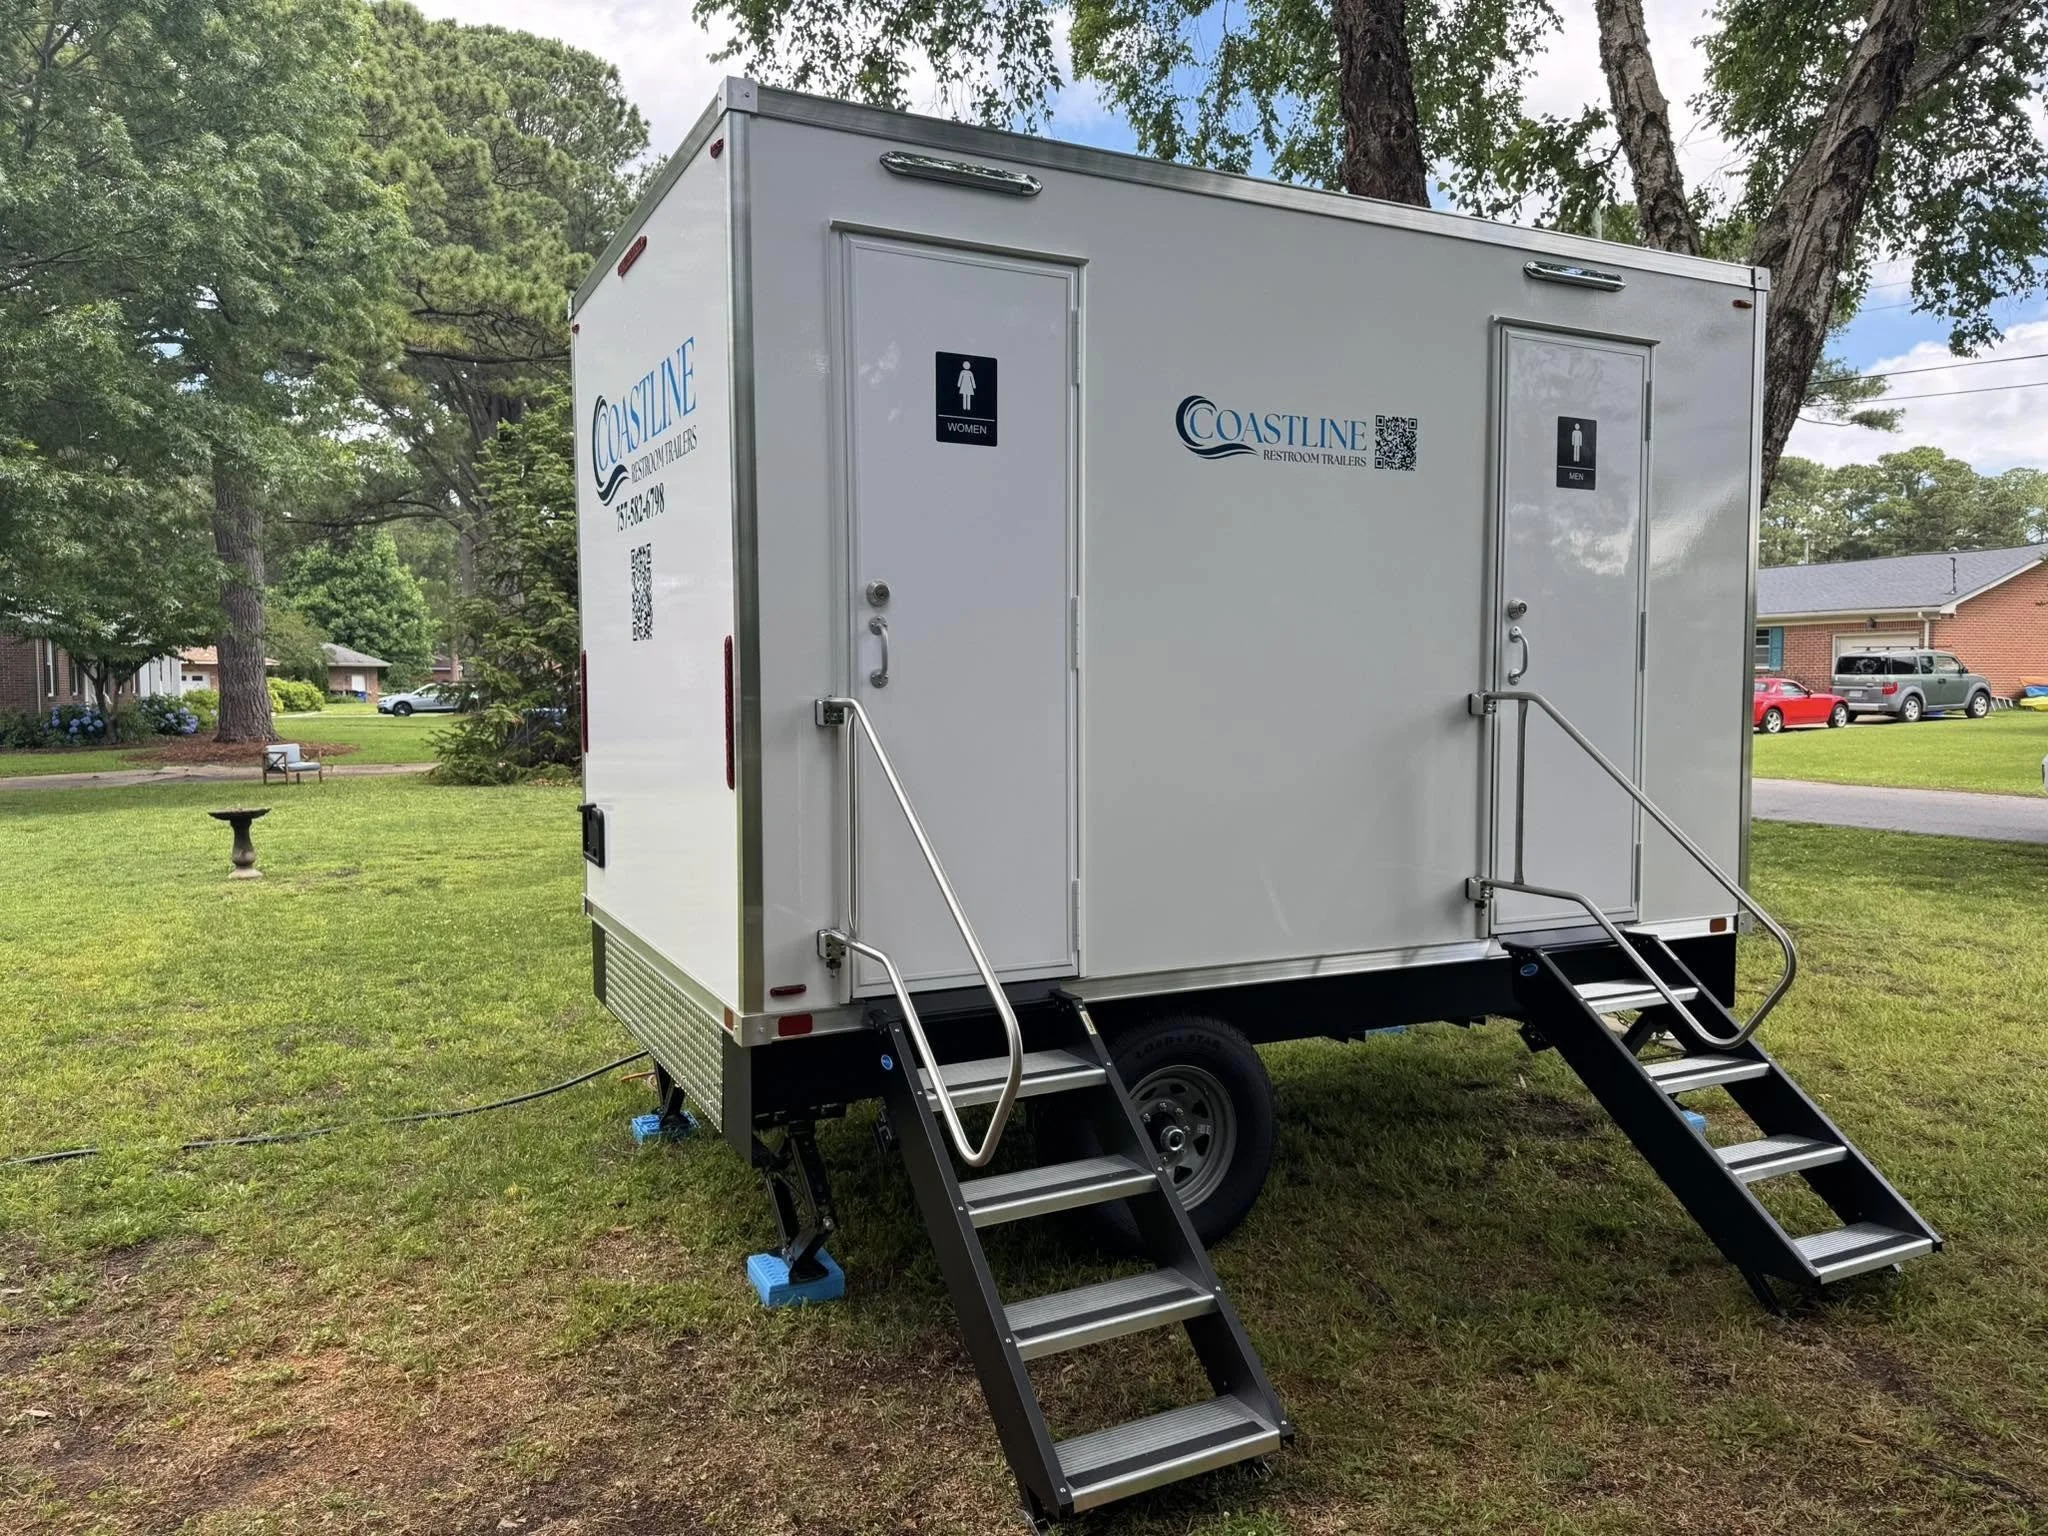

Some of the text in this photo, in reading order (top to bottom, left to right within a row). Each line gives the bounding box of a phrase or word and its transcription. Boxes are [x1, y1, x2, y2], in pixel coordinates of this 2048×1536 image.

[597, 336, 696, 472] COASTLINE
[947, 422, 987, 434] WOMEN
[1189, 407, 1367, 451] COASTLINE
[631, 424, 698, 484] RESTROOM TRAILERS
[1263, 449, 1367, 468] RESTROOM TRAILERS
[1568, 471, 1584, 481] MEN
[616, 482, 665, 532] 757-582-6798
